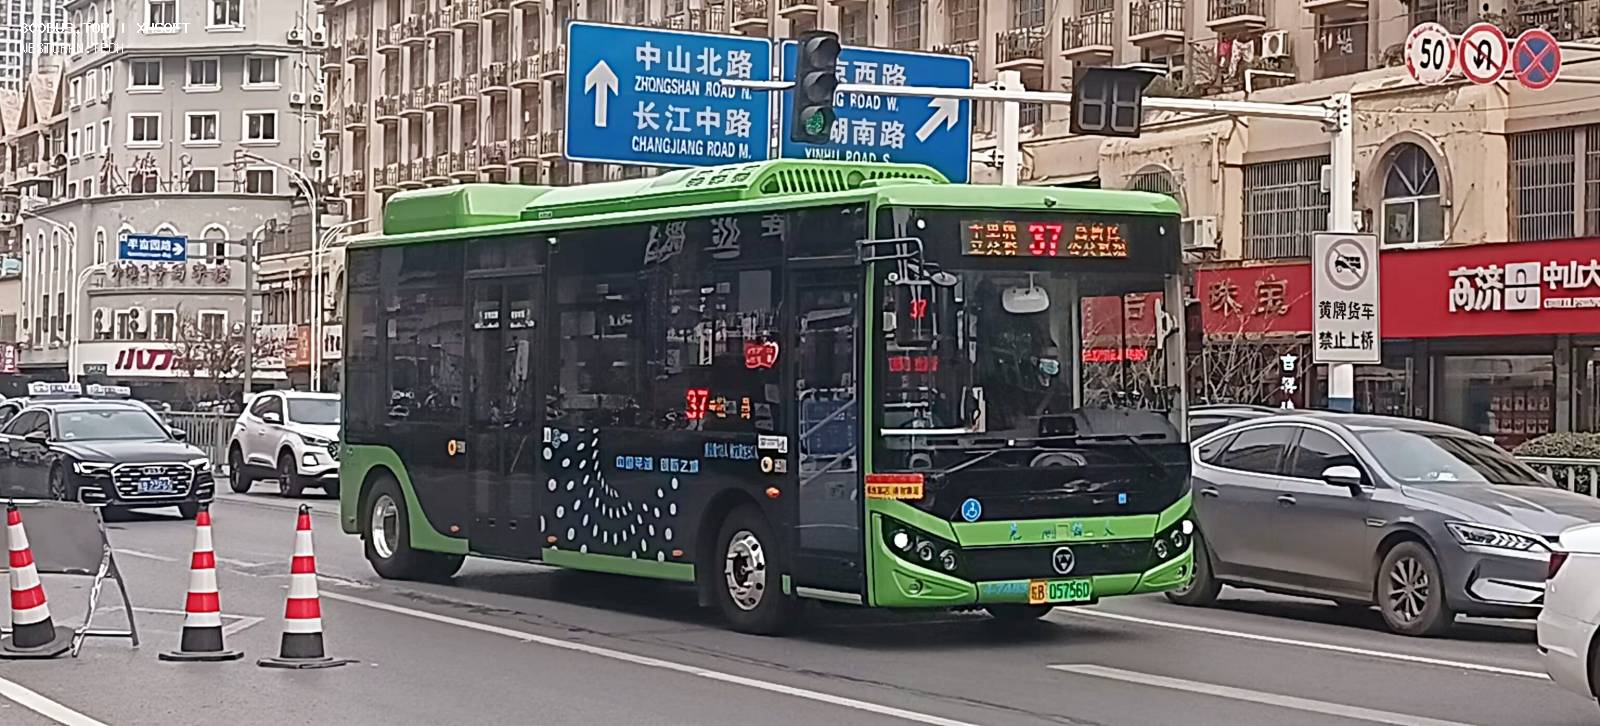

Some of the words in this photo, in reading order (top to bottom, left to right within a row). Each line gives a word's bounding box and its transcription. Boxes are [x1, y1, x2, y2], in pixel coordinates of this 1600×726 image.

[635, 41, 752, 79] 中山北路
[1420, 38, 1445, 70] 50
[634, 75, 700, 96] ZHONGSHAN
[705, 80, 736, 98] ROAD
[836, 59, 907, 86] 京西路
[850, 93, 881, 110] ROAD
[887, 97, 899, 112] W.
[633, 101, 752, 138] 长江中路
[830, 117, 905, 149] 湖南路
[632, 136, 703, 156] CHANGJIANG
[707, 142, 736, 158] ROAD
[738, 143, 752, 159] M.
[1028, 223, 1063, 256] 37
[1208, 274, 1289, 318] 珠宝
[1448, 263, 1504, 313] 高济
[908, 299, 928, 320] 37
[1318, 301, 1375, 320] 黄牌货车
[1318, 331, 1374, 350] 禁止上桥
[685, 389, 709, 419] 37
